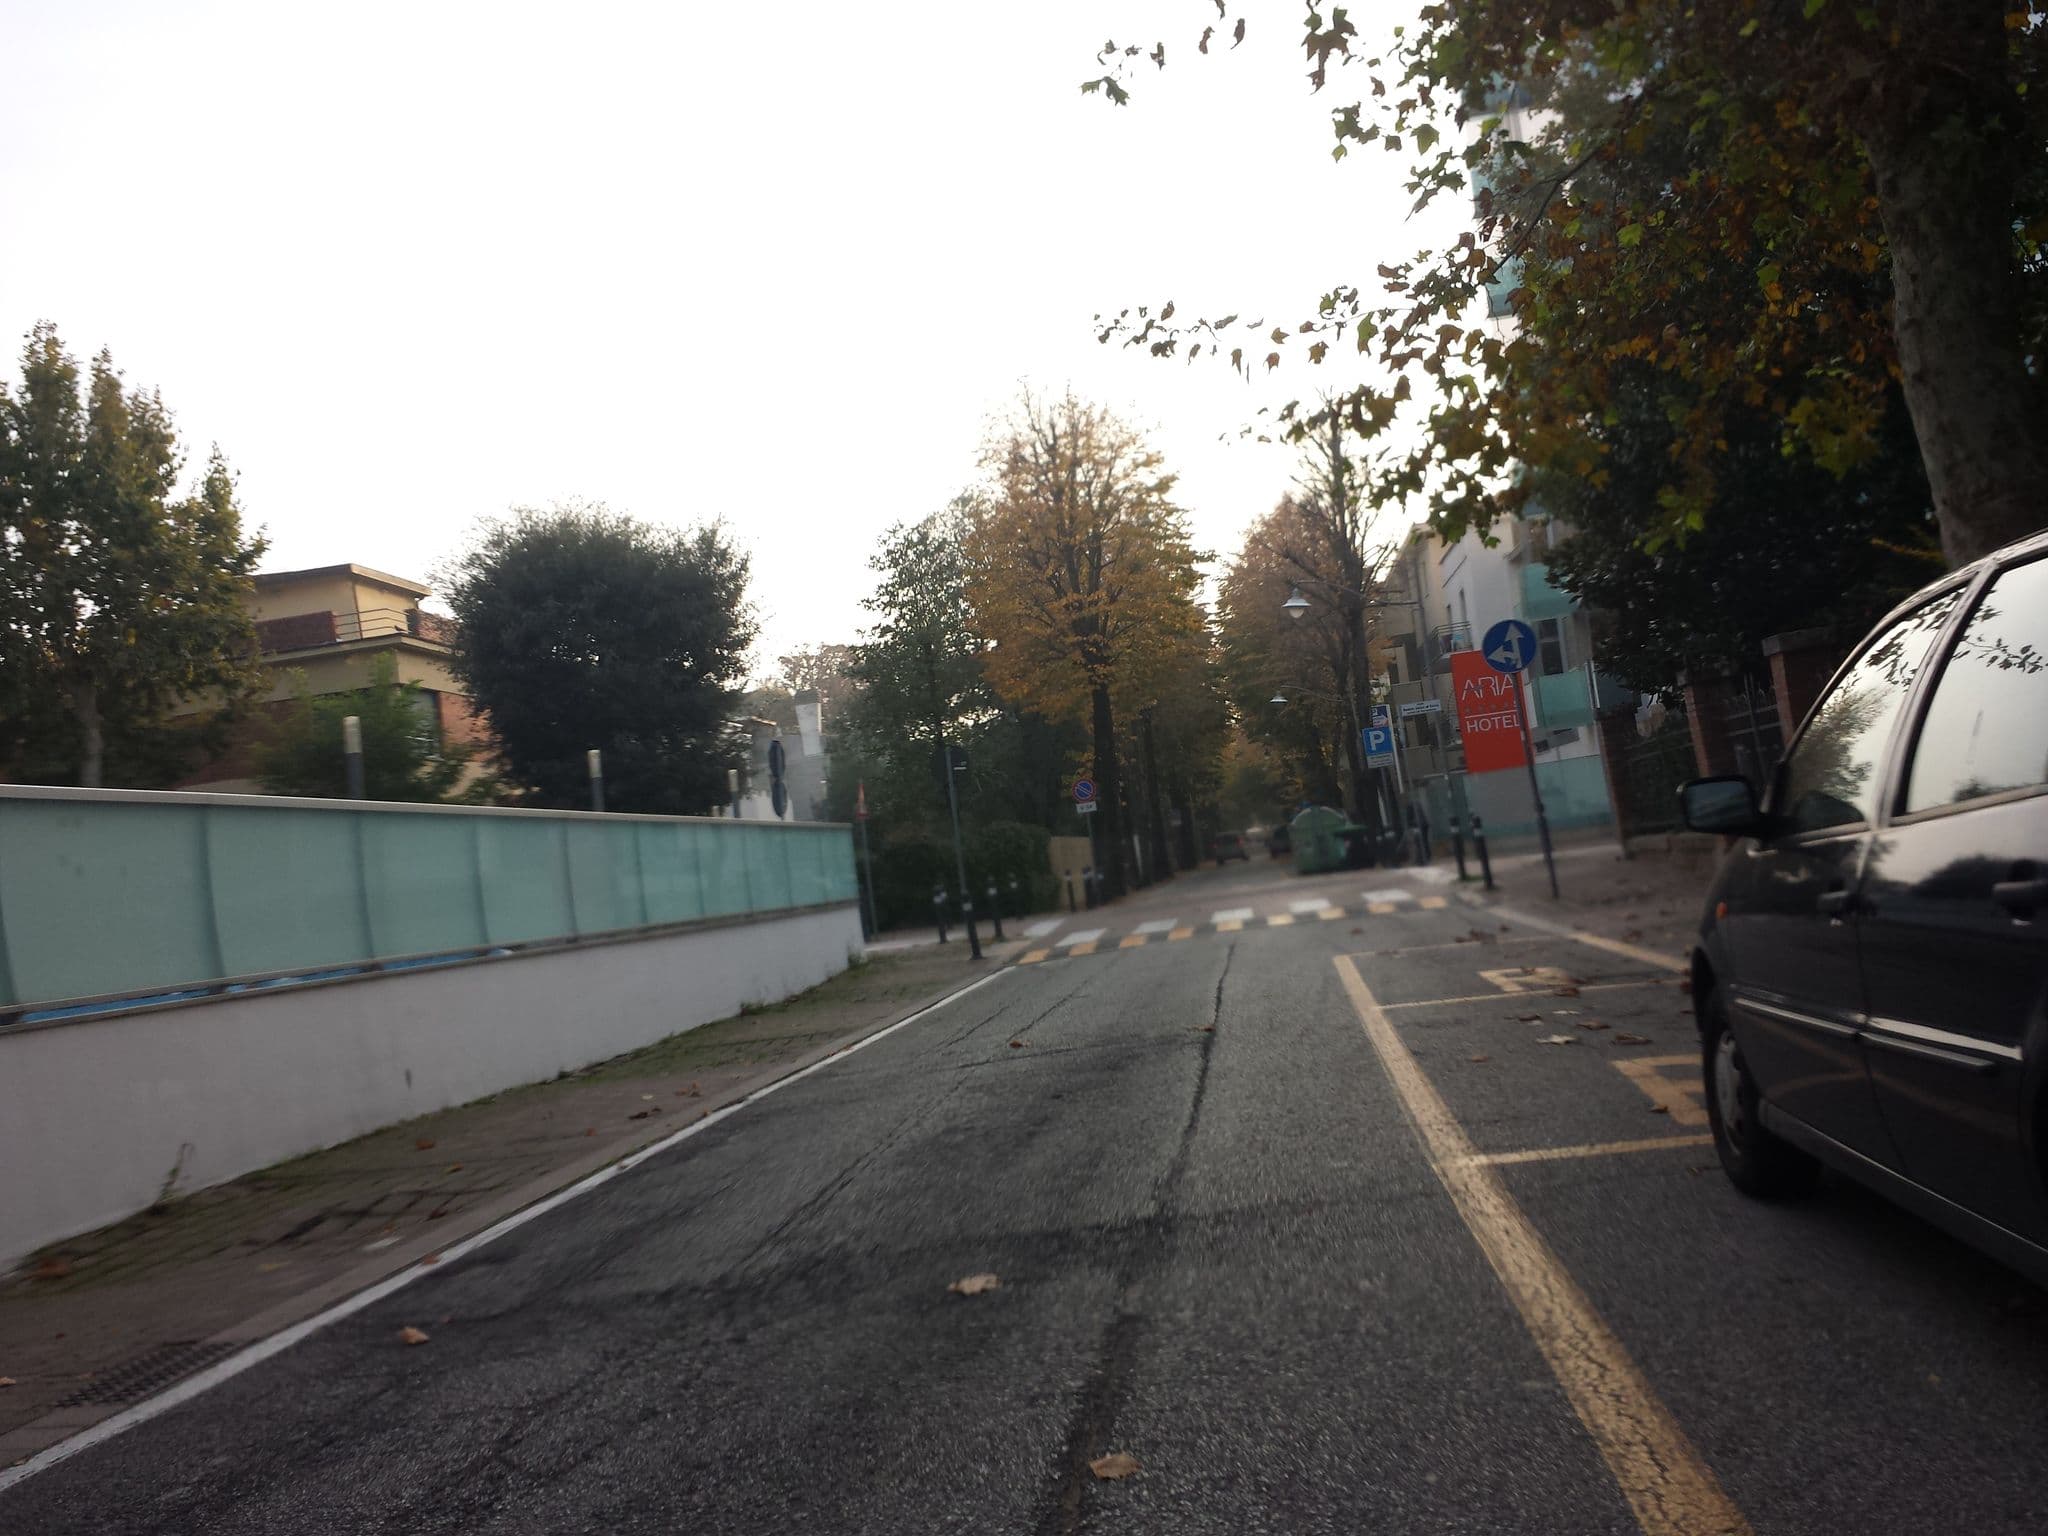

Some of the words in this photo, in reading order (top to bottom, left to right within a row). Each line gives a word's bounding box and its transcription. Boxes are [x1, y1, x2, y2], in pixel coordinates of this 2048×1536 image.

[1462, 674, 1514, 701] ARIA
[1466, 715, 1521, 734] HOTEL
[1369, 730, 1386, 751] P
